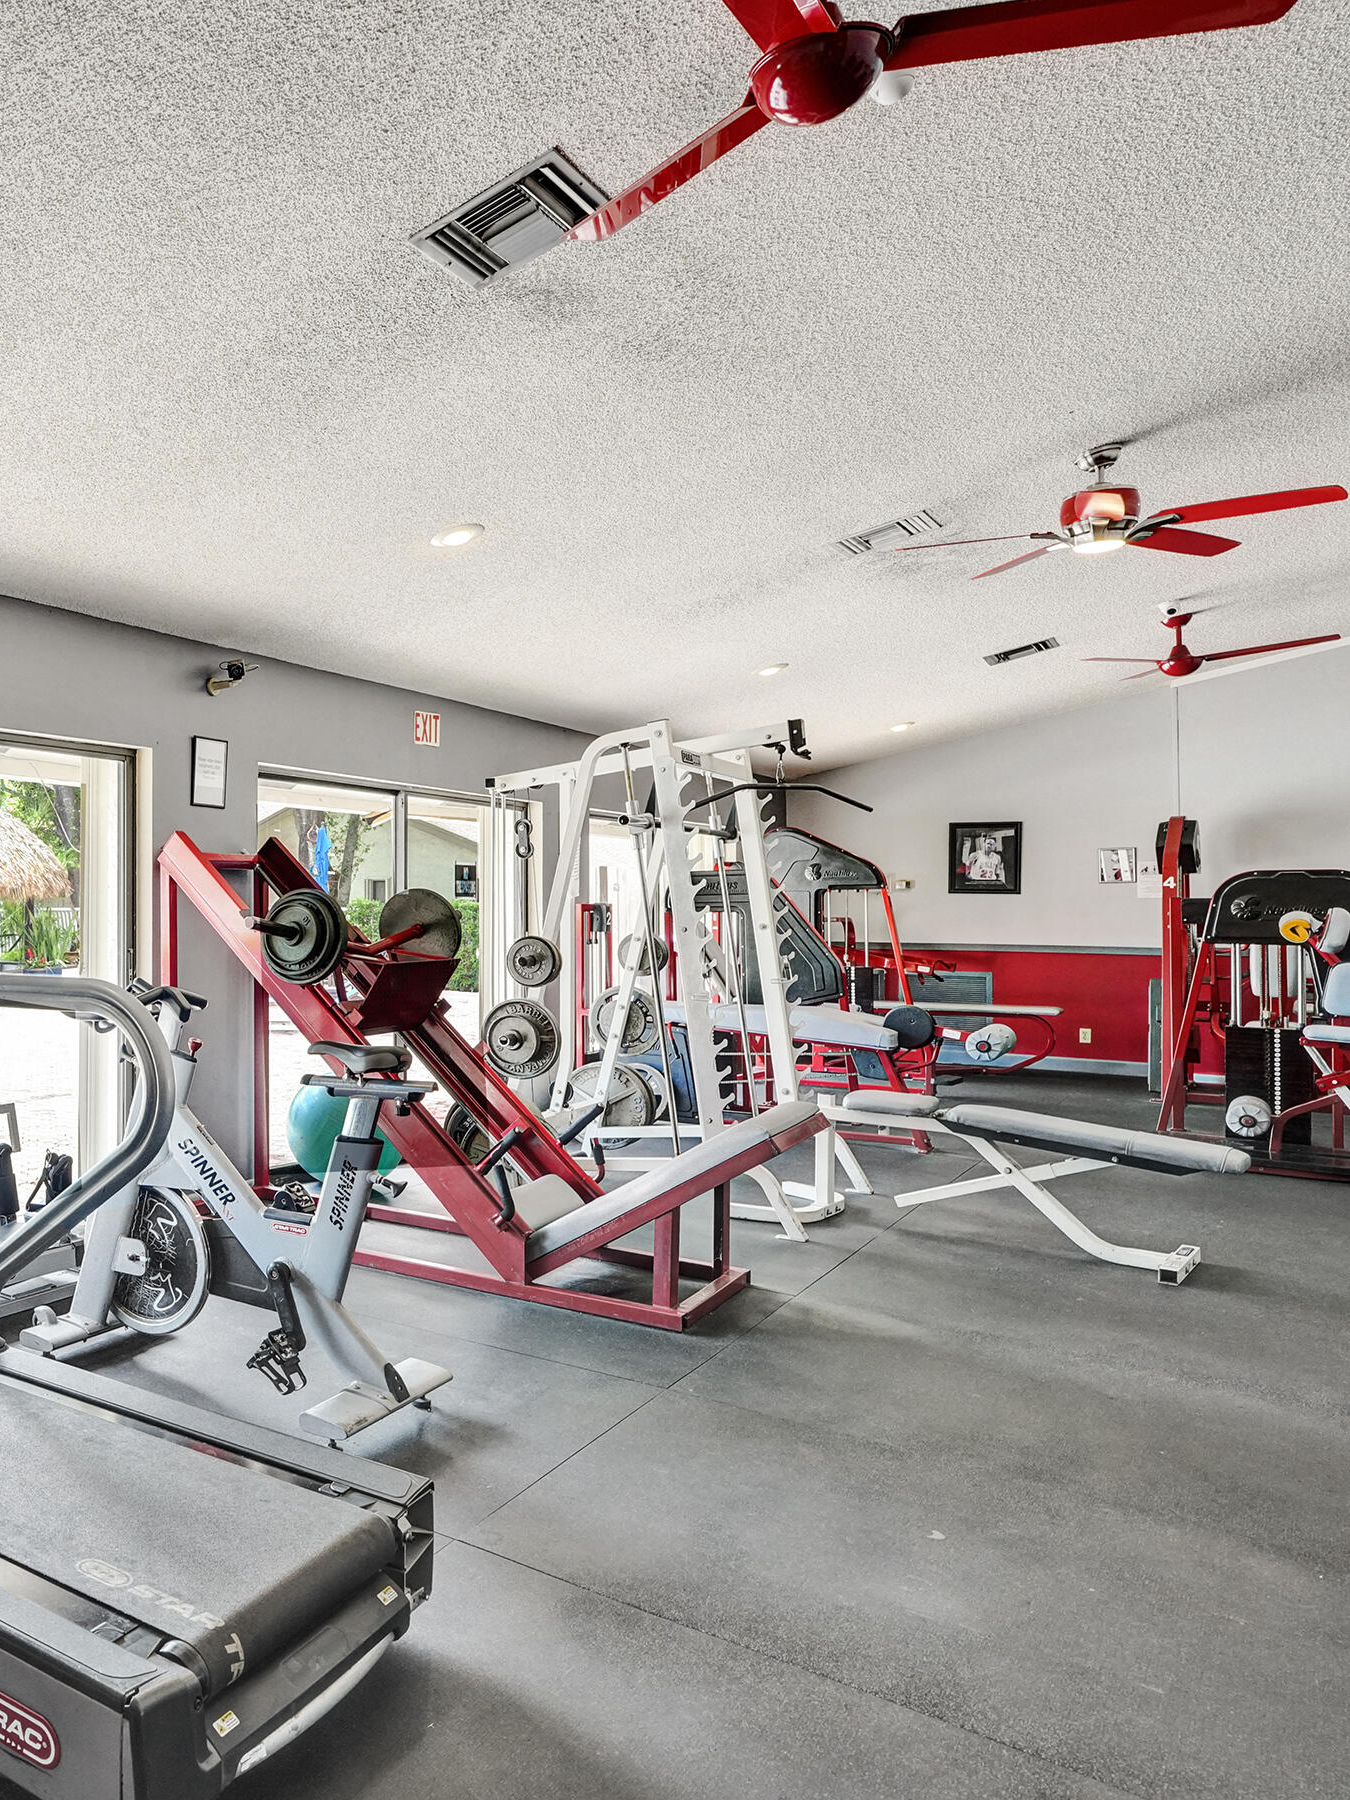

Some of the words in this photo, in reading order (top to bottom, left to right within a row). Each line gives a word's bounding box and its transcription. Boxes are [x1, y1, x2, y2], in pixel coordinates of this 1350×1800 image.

[415, 712, 440, 744] EXIT
[980, 869, 994, 879] 23
[1163, 876, 1177, 889] 4
[606, 912, 612, 926] 2
[178, 1138, 236, 1206] SPINNER
[329, 1159, 358, 1231] SPINNER
[128, 1584, 226, 1630] STAR
